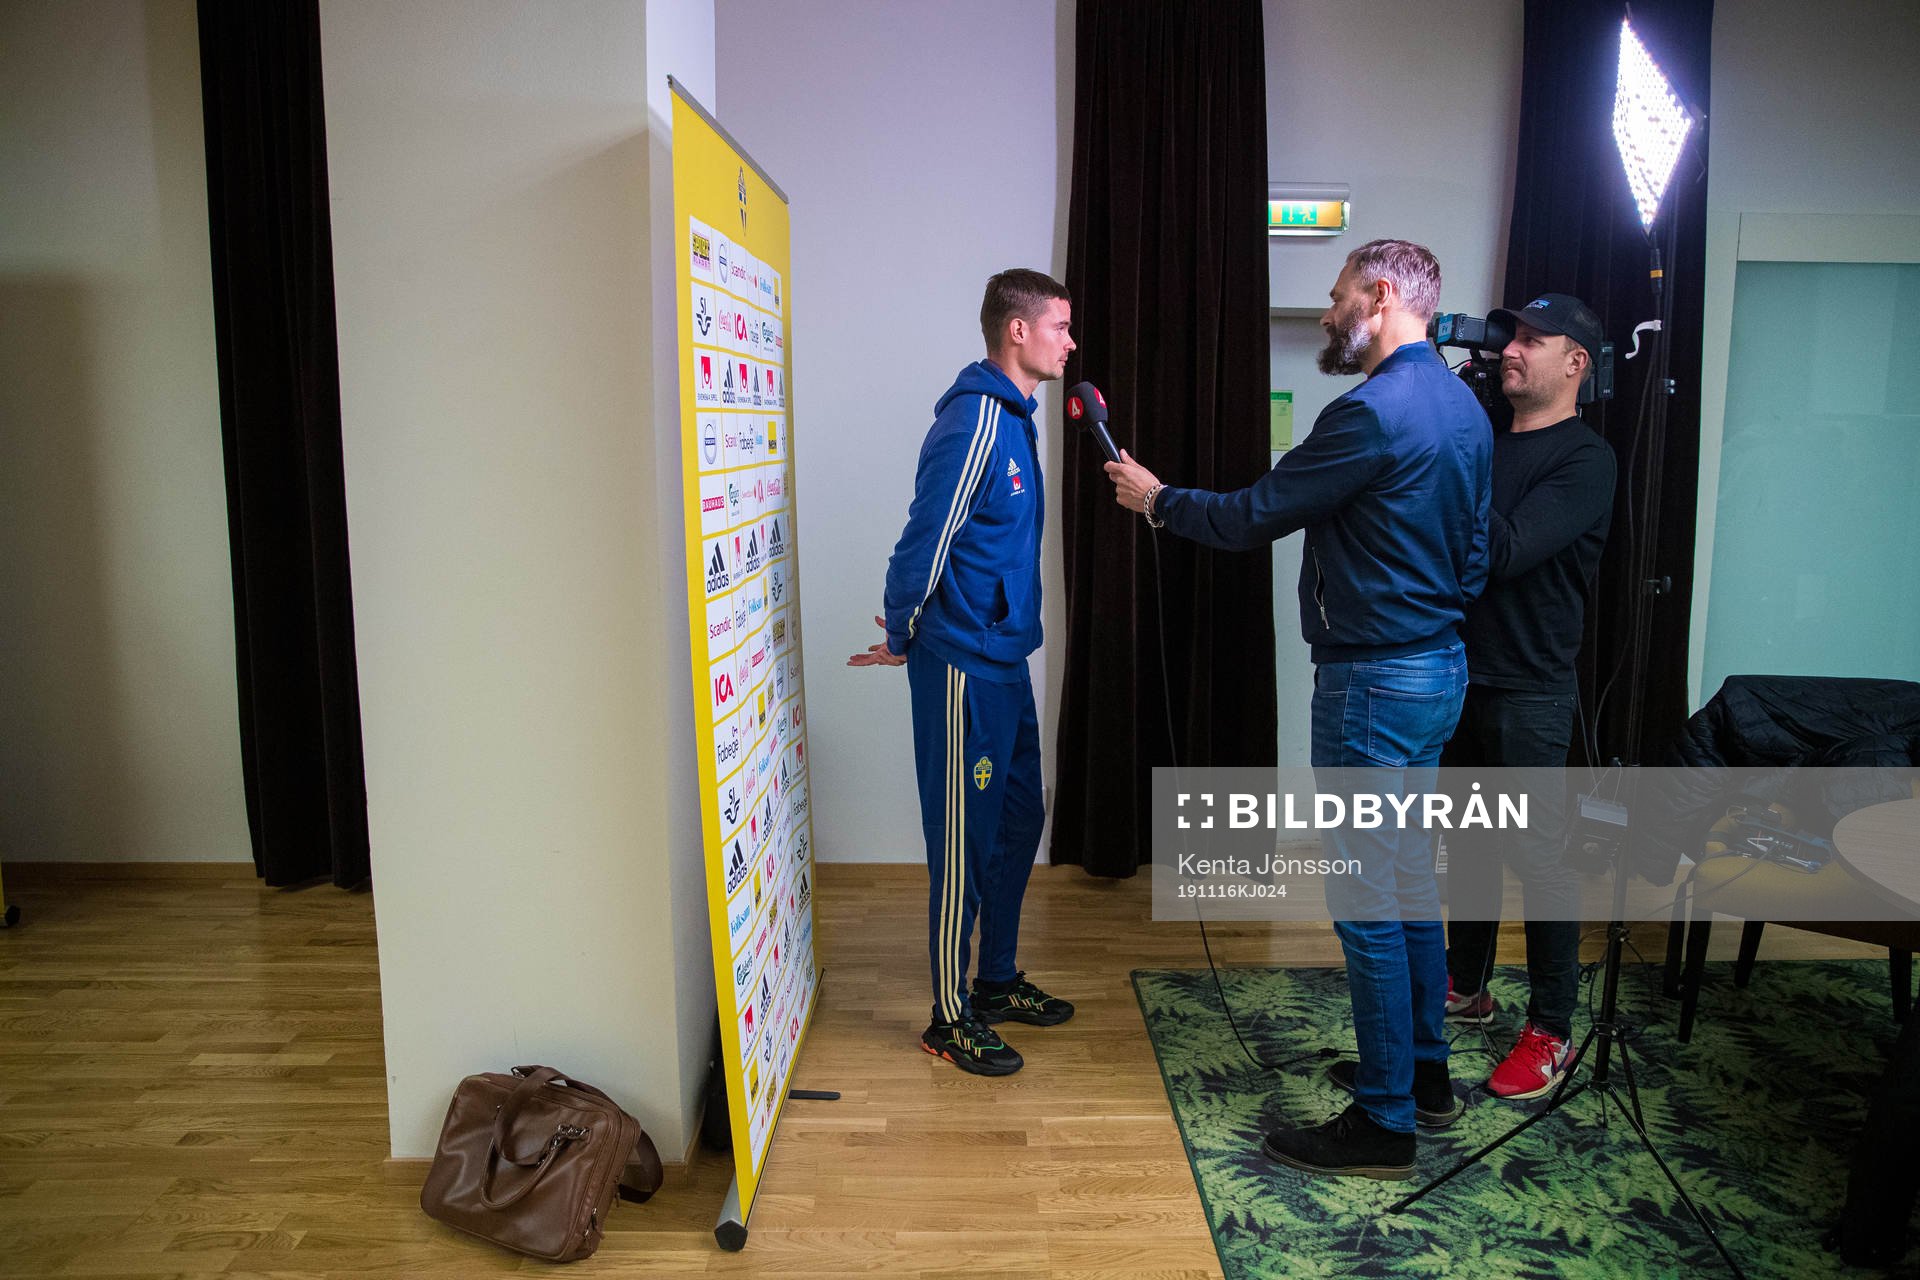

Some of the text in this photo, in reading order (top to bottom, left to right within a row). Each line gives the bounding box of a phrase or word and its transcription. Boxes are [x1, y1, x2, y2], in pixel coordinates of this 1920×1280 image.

[734, 313, 748, 342] ICA
[707, 571, 729, 593] adidas
[709, 616, 732, 639] Scandic
[715, 672, 734, 707] ICA
[717, 739, 739, 765] Fabege
[727, 863, 747, 894] adidas
